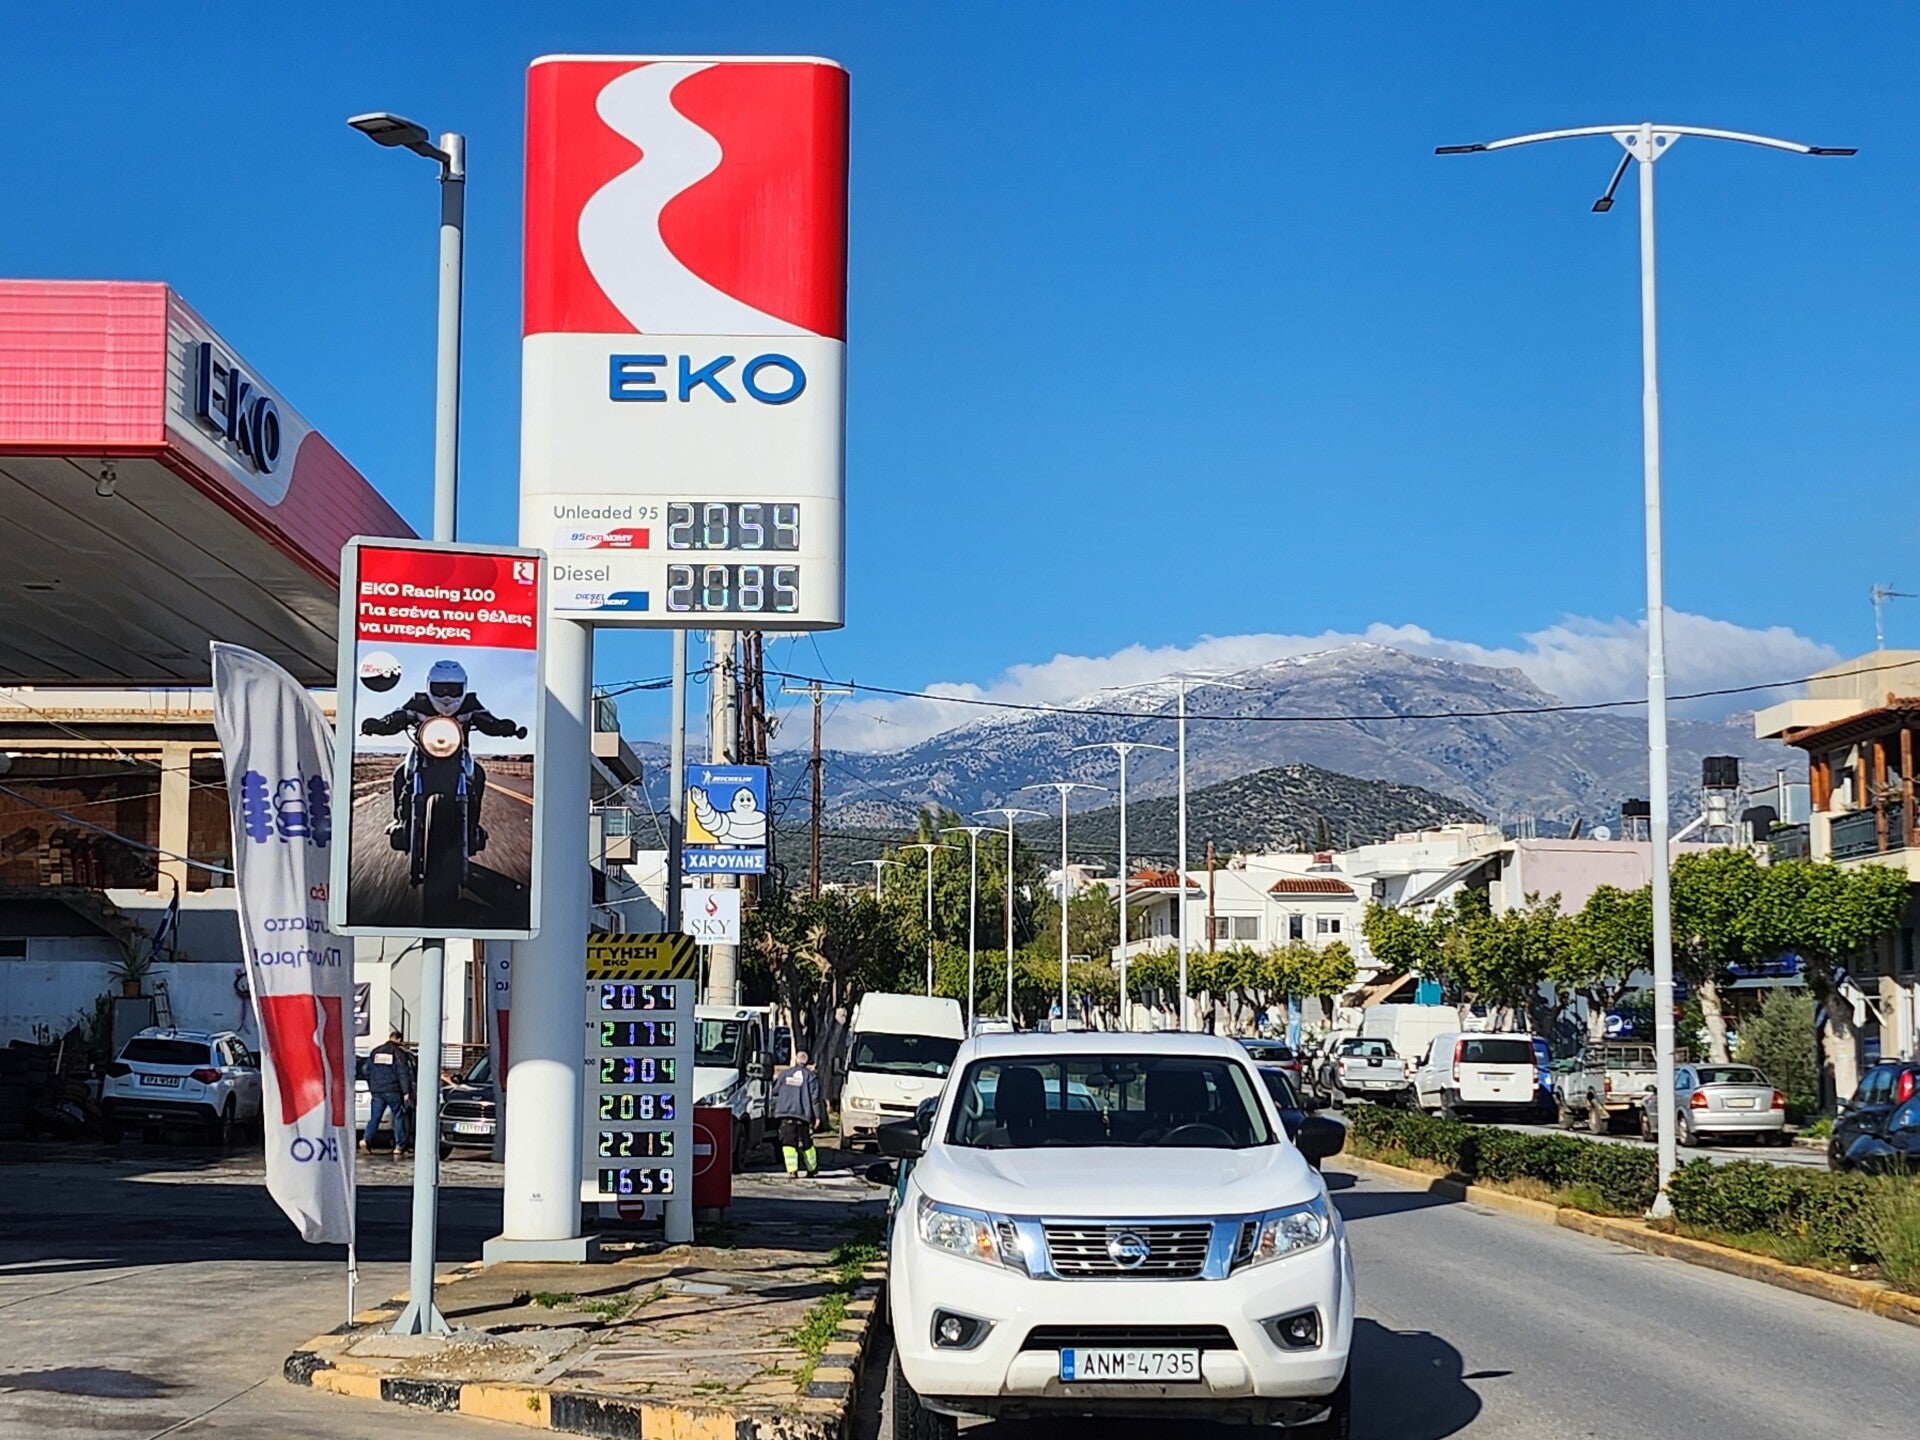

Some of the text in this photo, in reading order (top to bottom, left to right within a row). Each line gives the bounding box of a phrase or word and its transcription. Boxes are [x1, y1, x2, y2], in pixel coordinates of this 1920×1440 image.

[609, 353, 807, 405] EKO
[196, 342, 283, 474] EKO
[553, 505, 659, 520] Unleaded 95
[553, 565, 610, 581] Diesel
[360, 582, 496, 602] EKO Racing 100
[360, 602, 533, 627] Για εσένα που θέλεις
[359, 621, 472, 640] να υπερέχεις
[689, 854, 764, 869] ΧΑΡΟΥΛΗΣ
[691, 918, 732, 935] SKY
[586, 947, 657, 959] ΓΓΥΗΣΗ
[602, 959, 629, 967] EKO
[602, 985, 675, 1009] 2054
[602, 1021, 675, 1046] 2174
[602, 1058, 675, 1083] 2304
[600, 1094, 674, 1120] 2085
[600, 1131, 674, 1156] 2215
[607, 1168, 674, 1193] 1659
